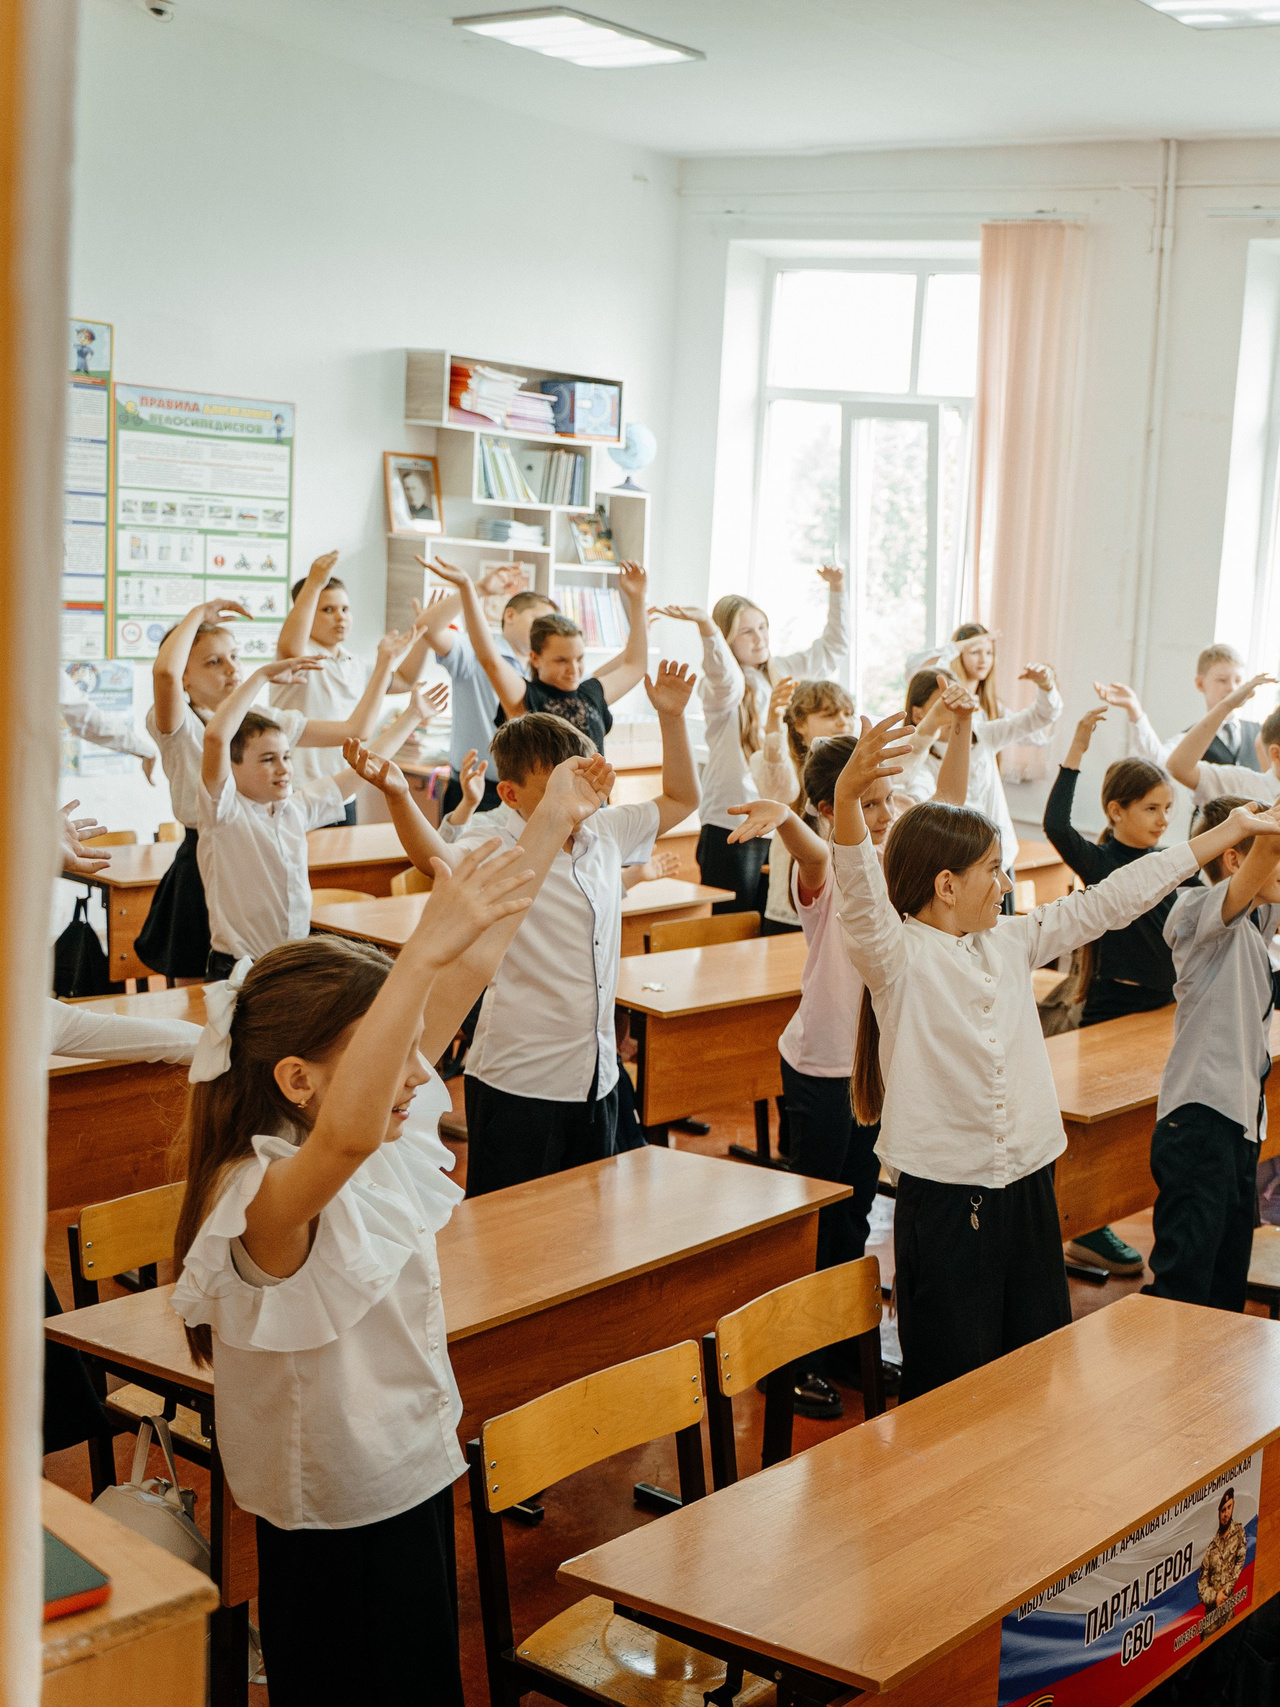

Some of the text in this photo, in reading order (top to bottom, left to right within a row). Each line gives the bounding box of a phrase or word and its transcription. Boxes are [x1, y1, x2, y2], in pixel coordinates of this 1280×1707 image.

[140, 396, 200, 412] ПРАВИЛА
[149, 413, 263, 434] ВЕЛОСИПЕДИСТОВ
[1018, 1591, 1045, 1620] МБОУ
[1047, 1579, 1067, 1601] СОШ
[1068, 1566, 1083, 1587] №2
[1085, 1556, 1100, 1576] ИМ.
[1120, 1517, 1160, 1552] АРЧАКОВА
[1161, 1509, 1173, 1526] СТ.
[1175, 1456, 1252, 1517] СТАРОЩЕРБИНОВСКАЯ
[1085, 1541, 1193, 1646] ПАРТА ГЕРОЯ
[1121, 1614, 1154, 1665] СВО
